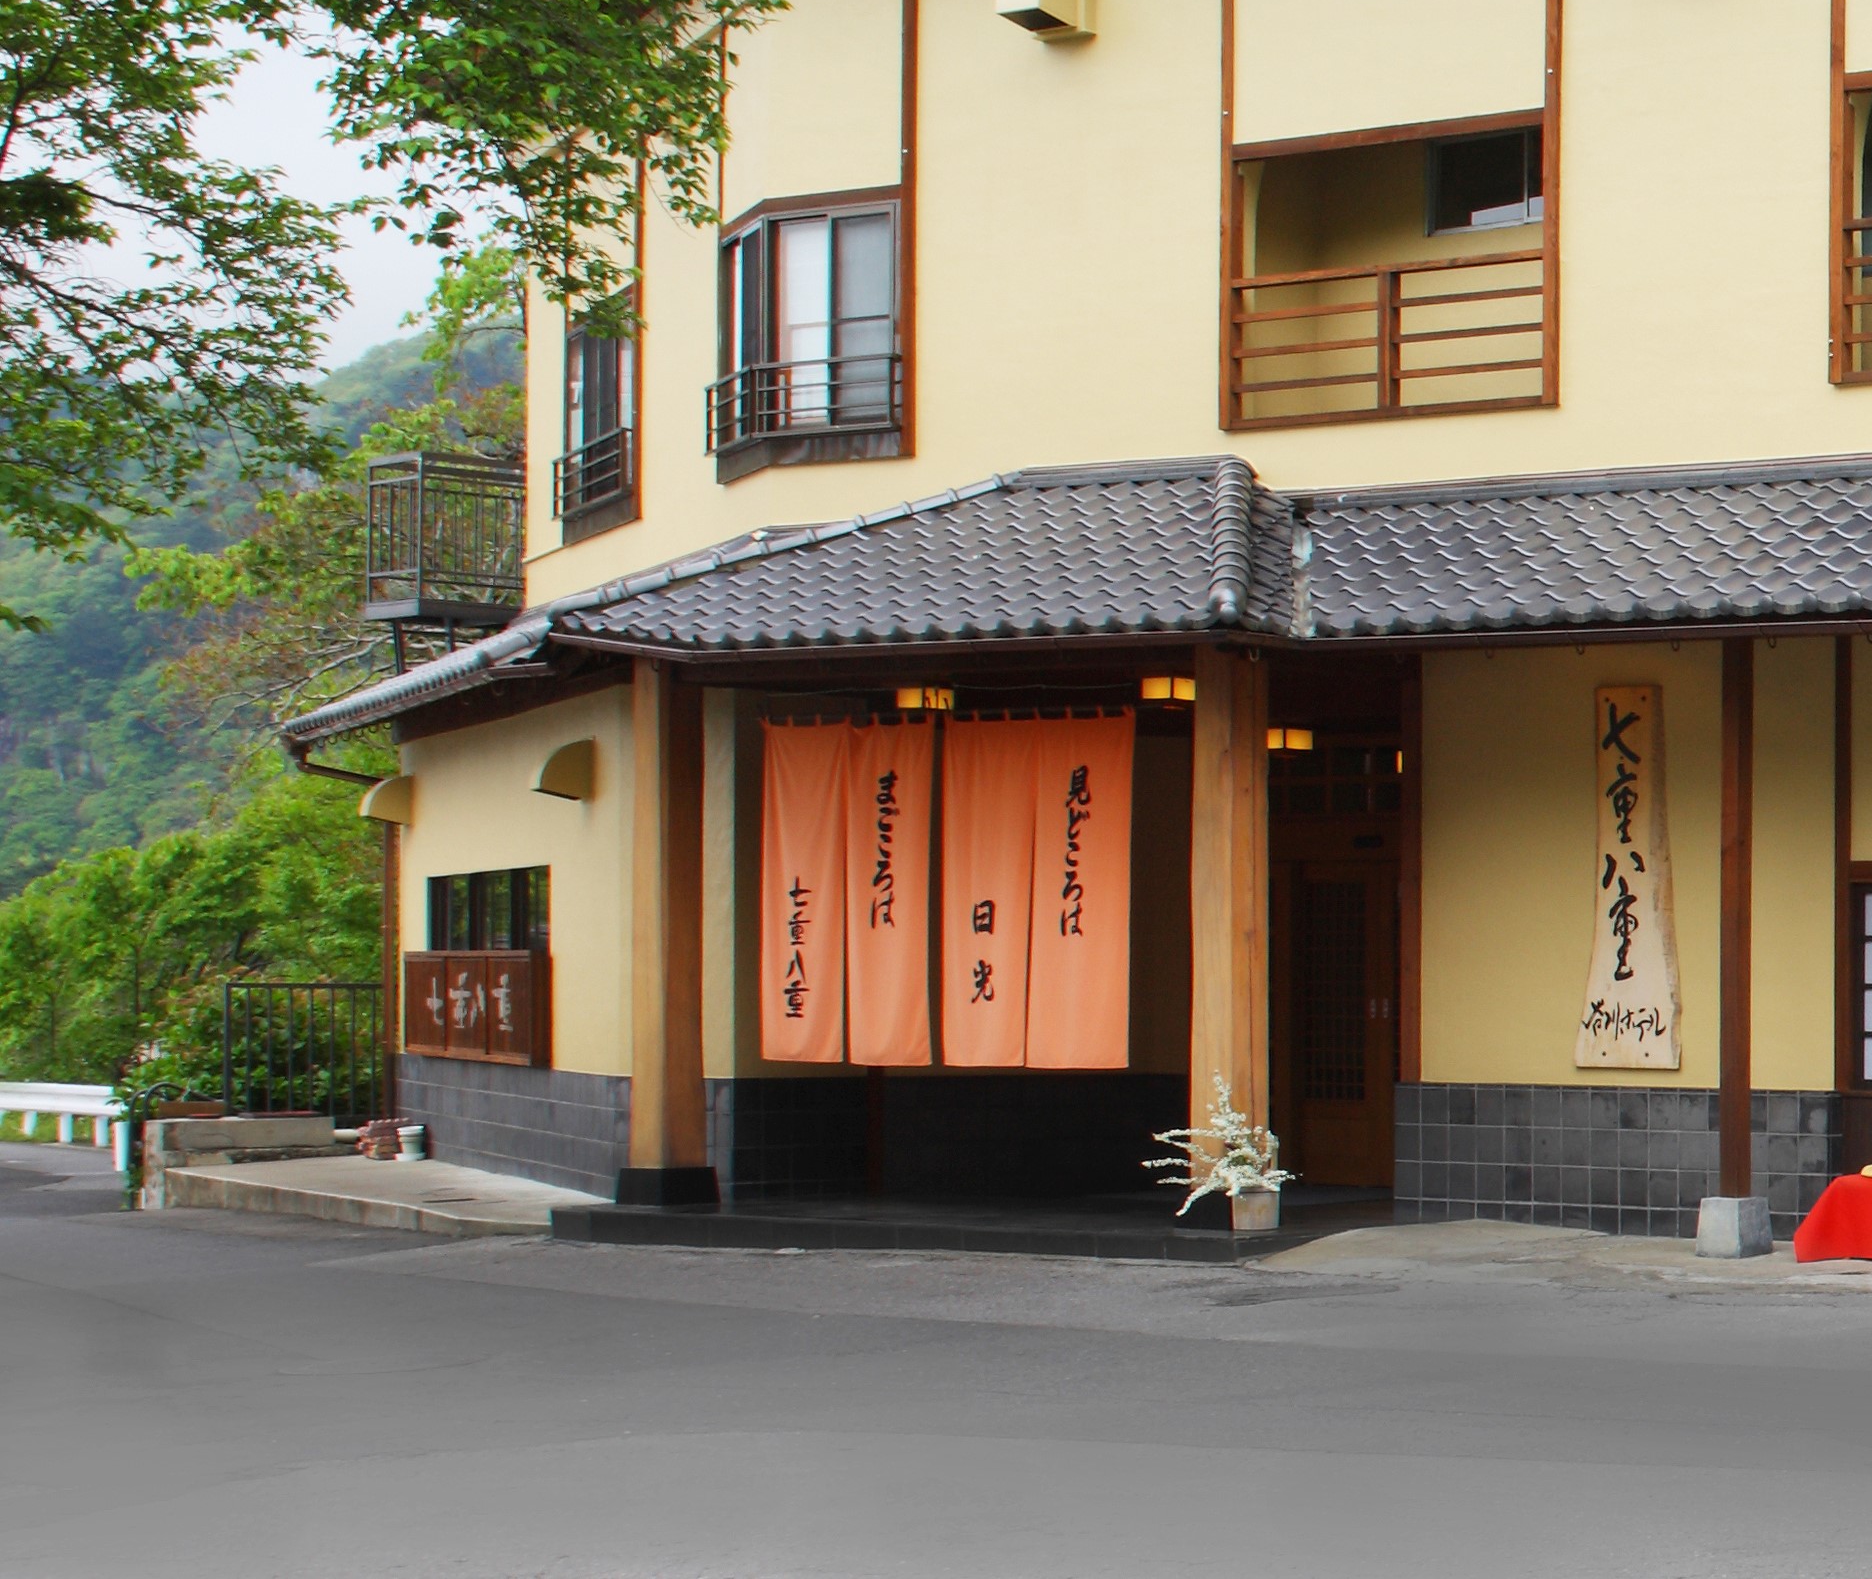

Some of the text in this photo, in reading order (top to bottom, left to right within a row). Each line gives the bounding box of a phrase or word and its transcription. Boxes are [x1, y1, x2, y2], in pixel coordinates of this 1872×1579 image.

[871, 769, 900, 930] まごころは
[1060, 764, 1092, 937] 見どころは
[1602, 702, 1645, 981] 七重八重
[427, 972, 513, 1031] 七重八重
[784, 876, 812, 1019] 七重八重
[971, 900, 995, 1004] 日光
